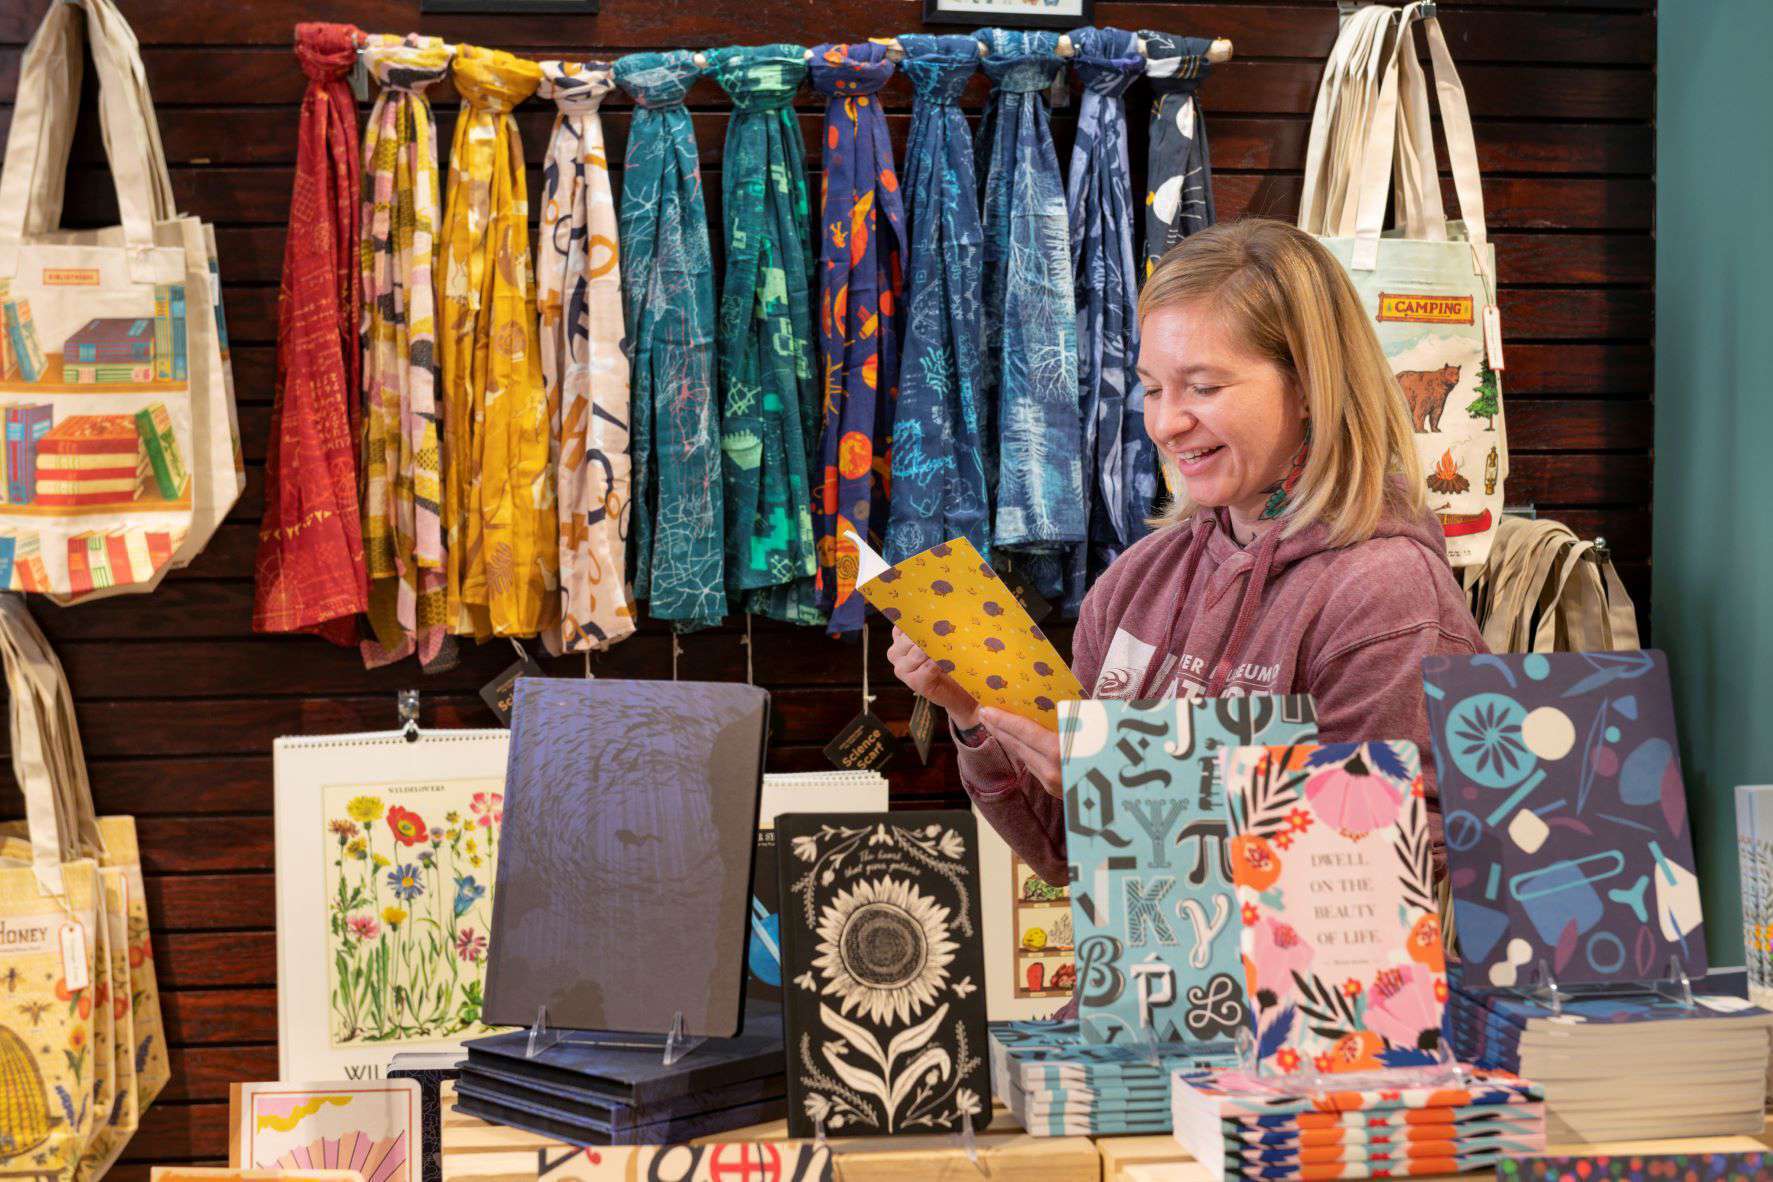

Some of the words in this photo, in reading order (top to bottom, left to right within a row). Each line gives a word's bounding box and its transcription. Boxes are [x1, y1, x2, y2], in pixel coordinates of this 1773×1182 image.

[1395, 301, 1462, 315] CAMPING
[842, 730, 881, 767] Science
[857, 741, 884, 769] Scarf
[1311, 853, 1370, 867] DWELL
[1310, 880, 1334, 892] ON
[1340, 878, 1375, 892] THE
[1313, 903, 1376, 919] BEAUTY
[1316, 932, 1339, 945] OF
